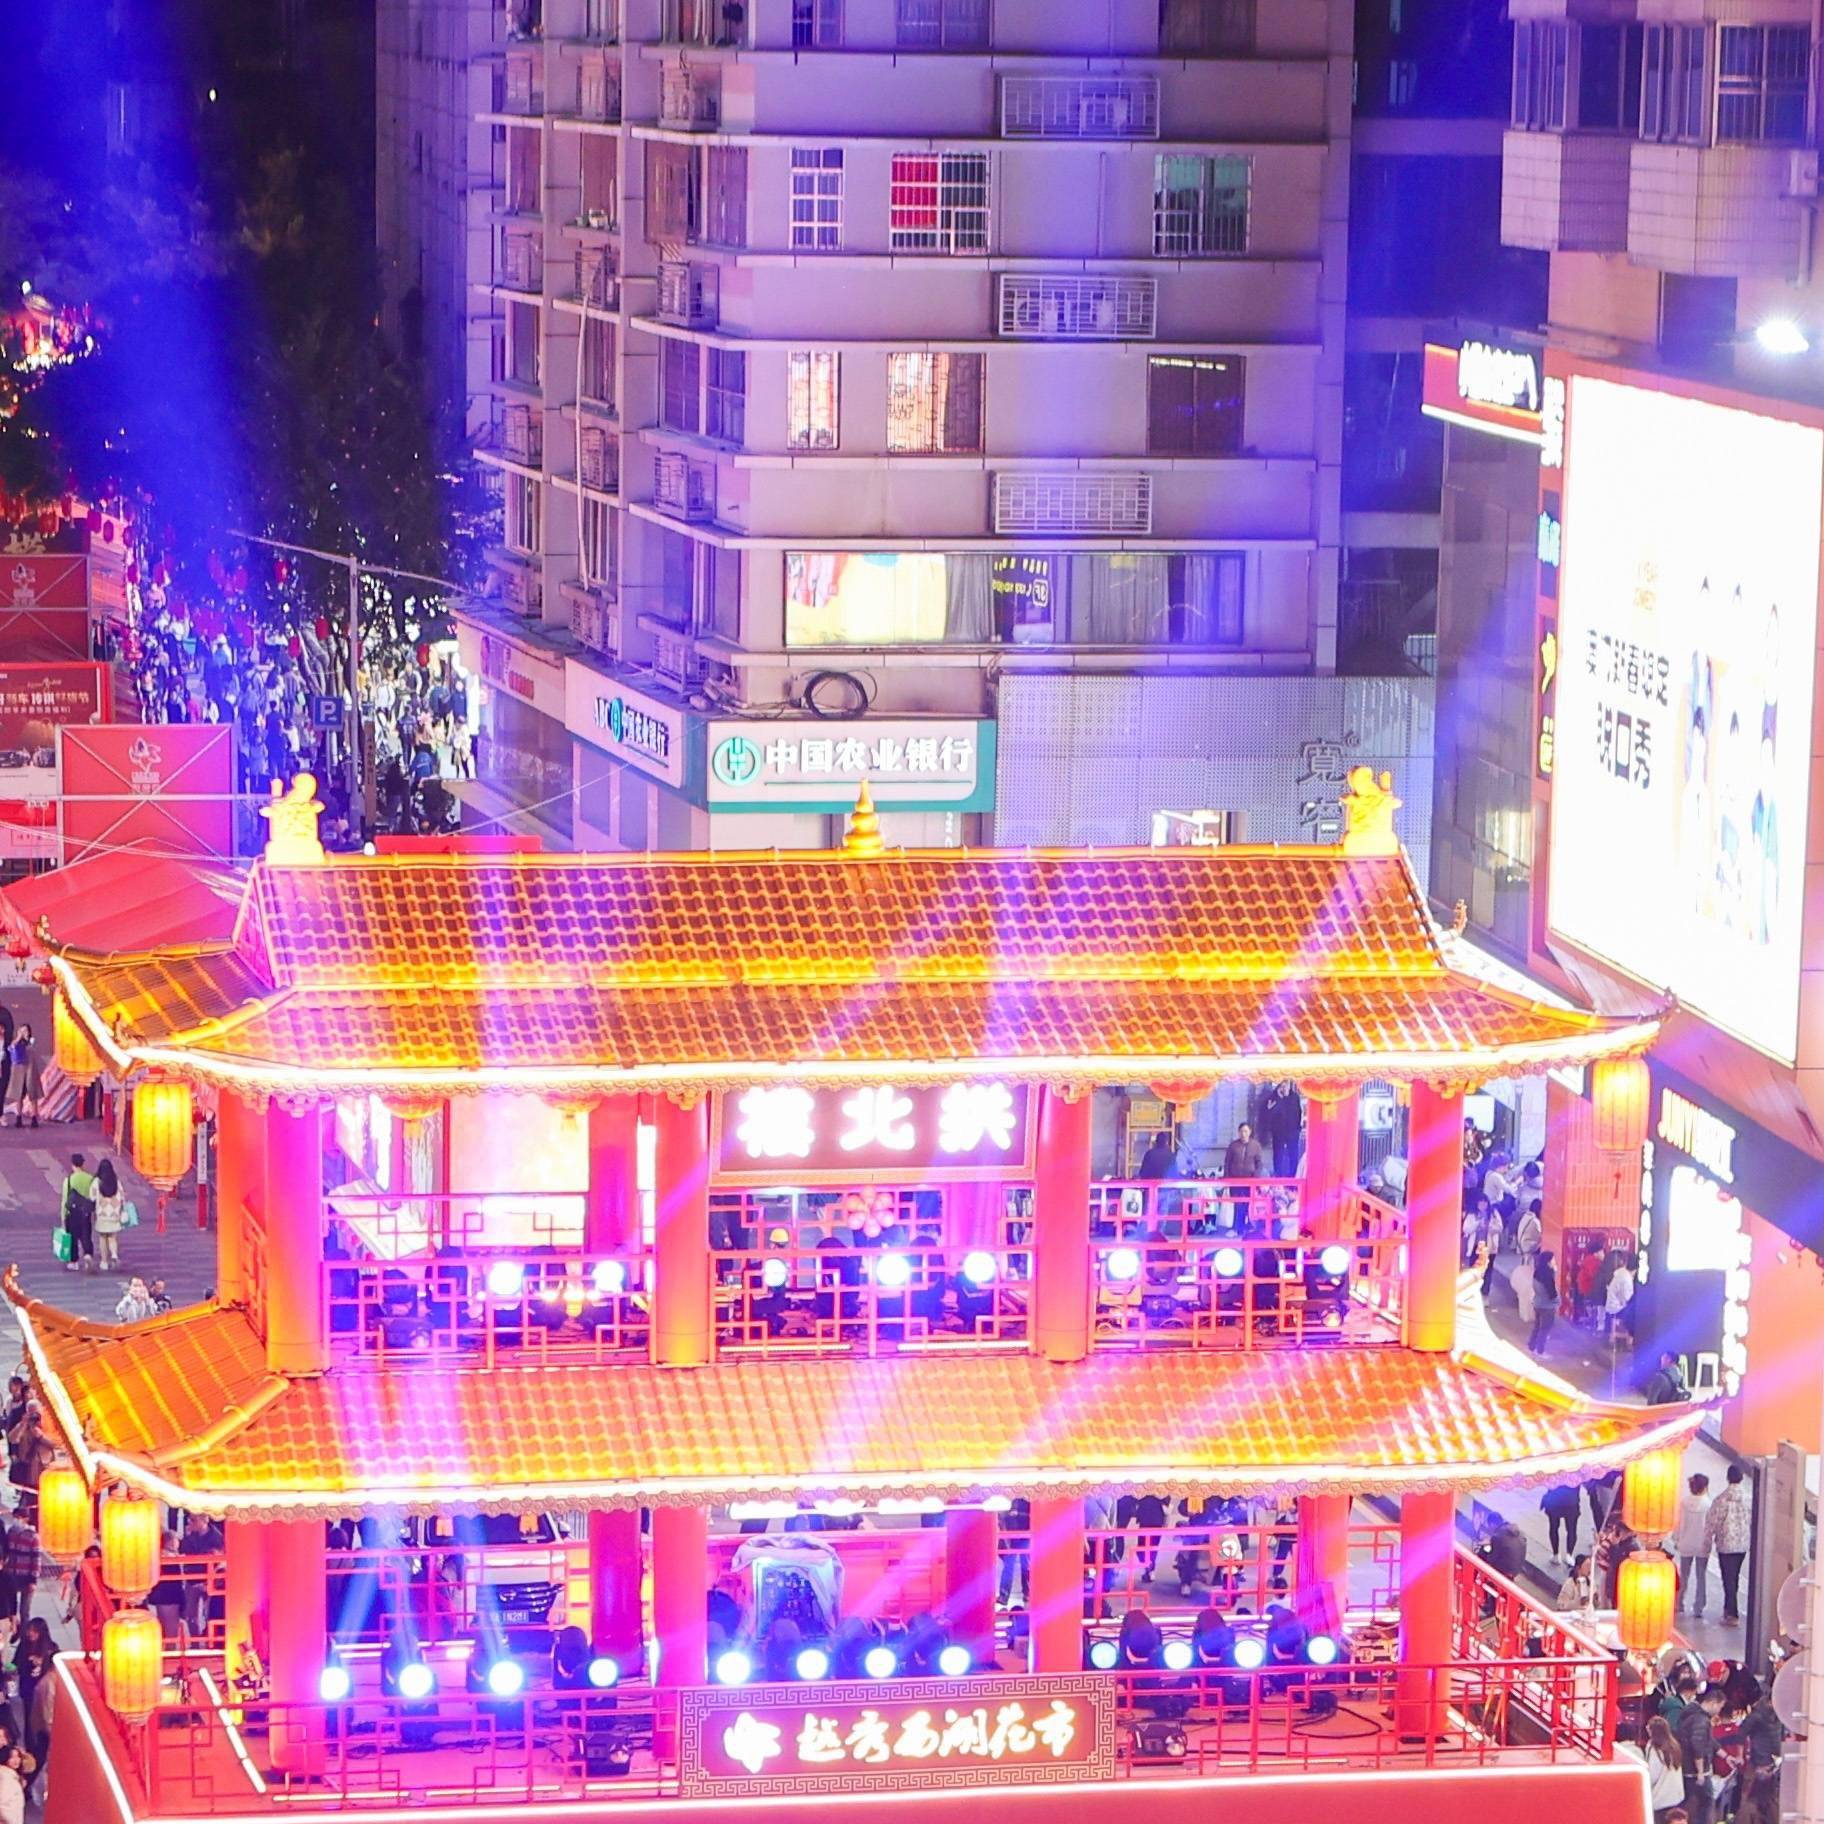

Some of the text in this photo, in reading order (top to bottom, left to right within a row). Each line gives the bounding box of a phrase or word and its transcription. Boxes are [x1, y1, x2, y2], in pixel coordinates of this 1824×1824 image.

[319, 700, 338, 721] P
[764, 736, 974, 774] 中国农业银行
